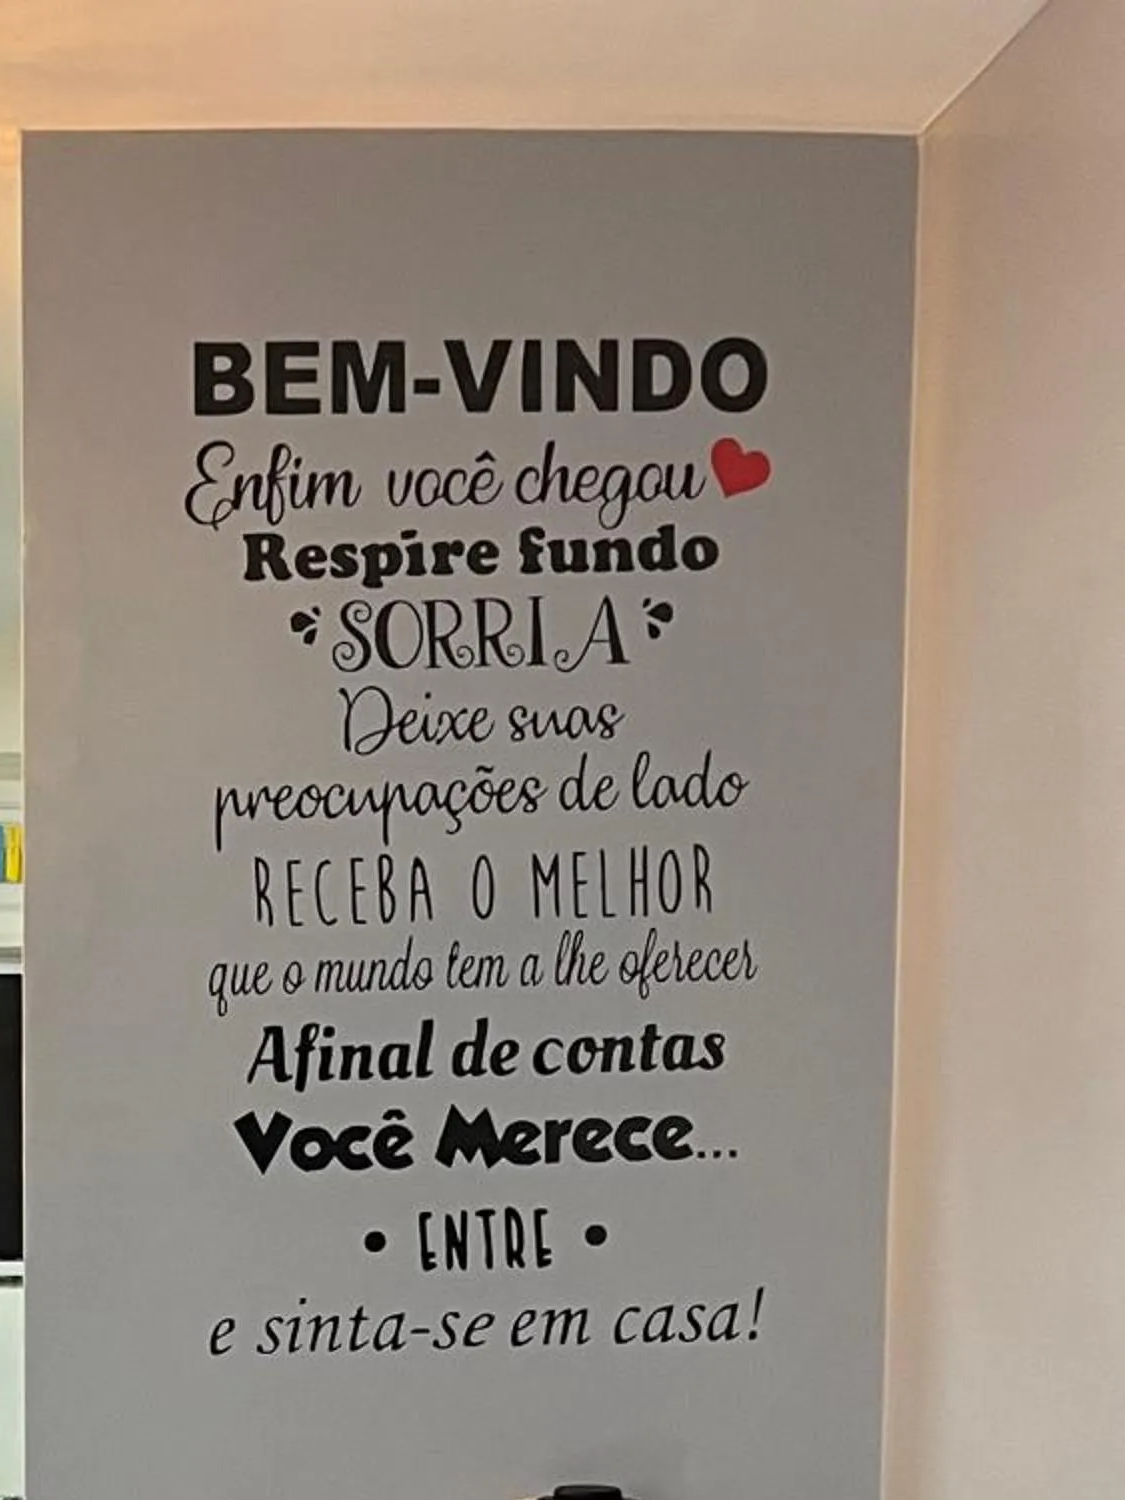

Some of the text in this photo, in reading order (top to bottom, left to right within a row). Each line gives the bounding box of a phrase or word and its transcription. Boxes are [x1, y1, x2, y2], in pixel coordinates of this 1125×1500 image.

[193, 337, 768, 417] BEM-VINDO
[184, 439, 708, 531] Enfim você chegou
[242, 523, 720, 590] Respire fundo
[331, 594, 631, 674] SORRIA
[337, 685, 626, 757] Deixe suas
[214, 748, 751, 853] preocupações de lado
[253, 842, 712, 928] RECEBA O MELHOR
[208, 927, 759, 1018] que o mundo tem a lhe oferecer
[246, 1016, 726, 1094] Afinal de contas
[232, 1103, 739, 1176] Você Merece...
[418, 1205, 553, 1273] ENTRE
[209, 1286, 765, 1357] e sinta-se em casa!
